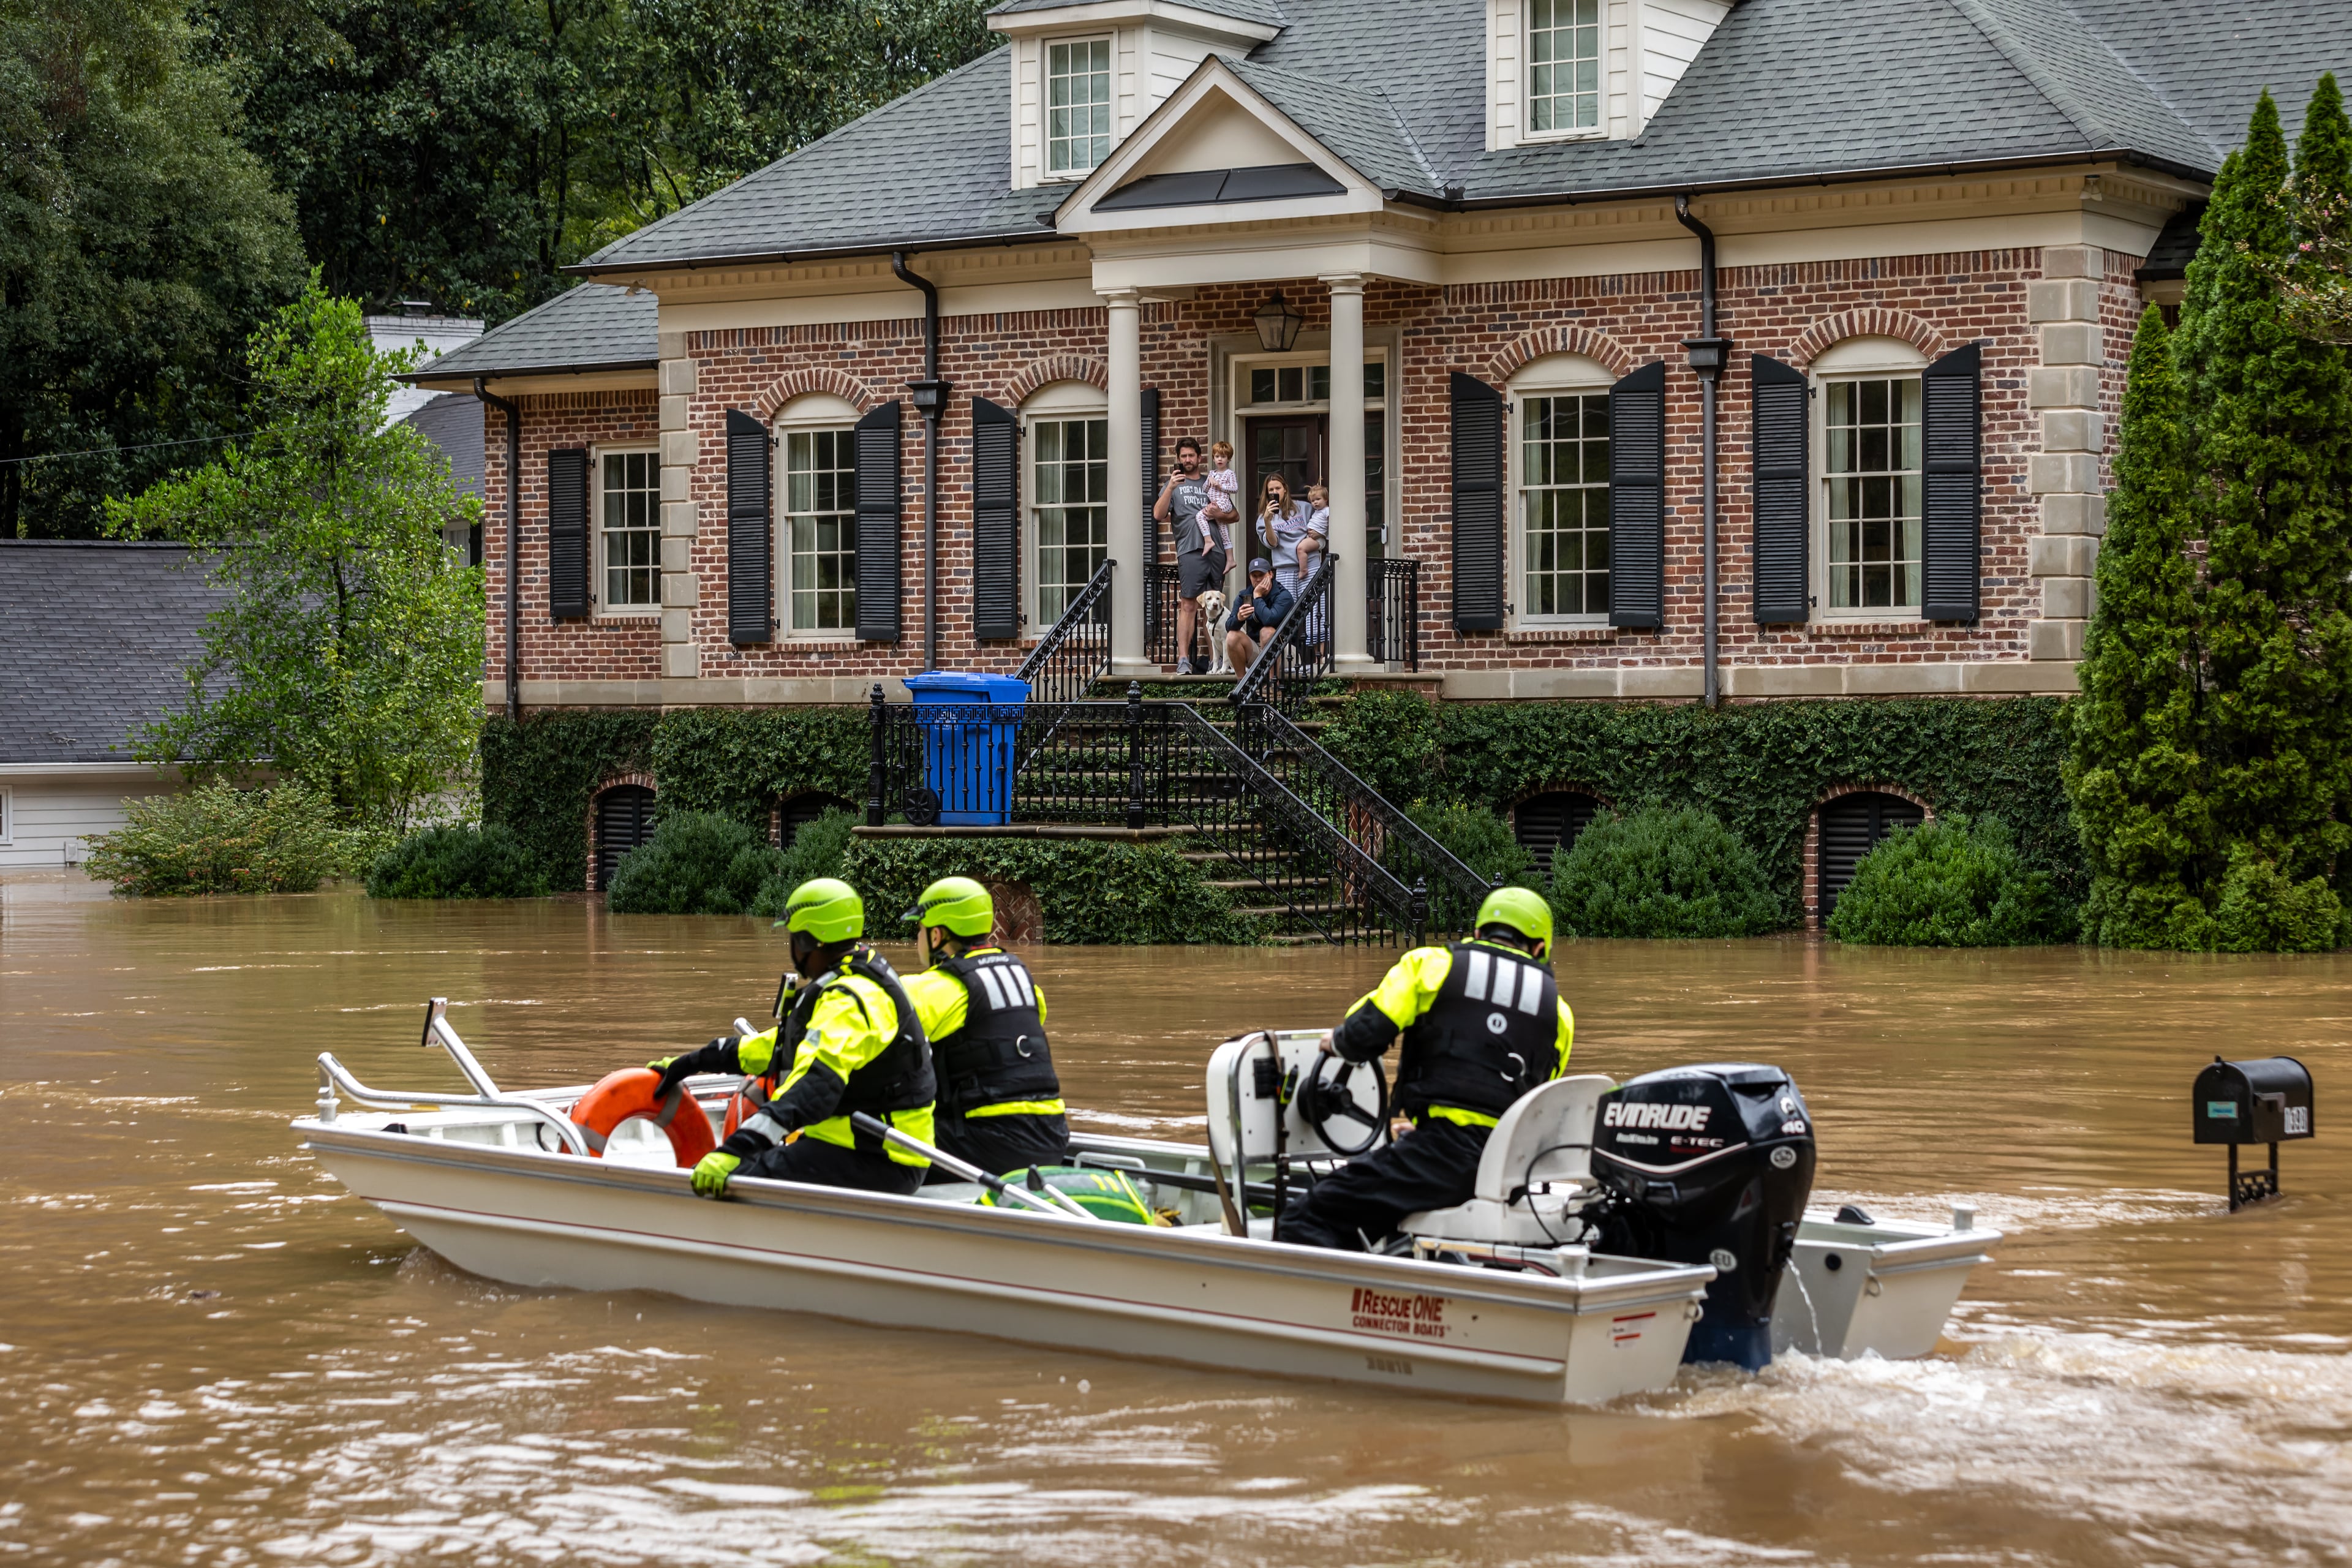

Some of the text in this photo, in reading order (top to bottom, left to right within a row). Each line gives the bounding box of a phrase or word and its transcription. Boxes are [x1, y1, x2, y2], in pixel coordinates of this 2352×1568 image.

[1194, 486, 1207, 495] DAL
[1604, 1102, 1711, 1131] EVINRUDE
[1670, 1136, 1725, 1148] E-TEC
[1362, 1289, 1444, 1322] RESCUE ONE
[1352, 1315, 1445, 1338] CONNECTOR BOATS
